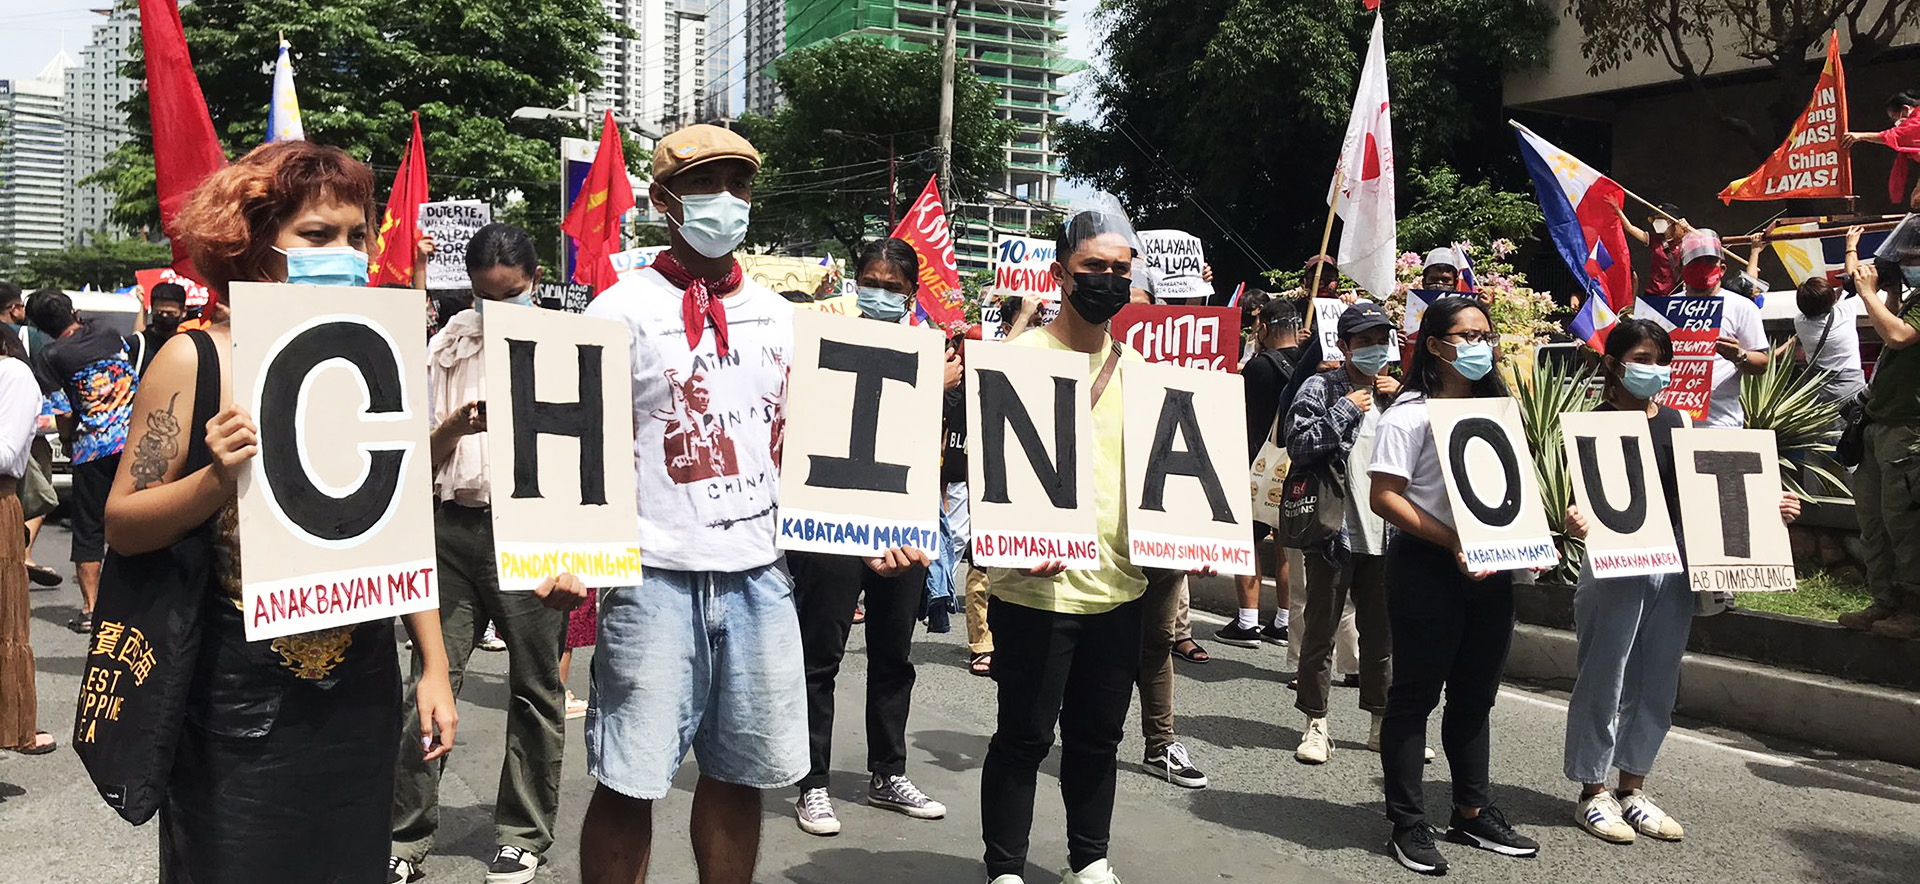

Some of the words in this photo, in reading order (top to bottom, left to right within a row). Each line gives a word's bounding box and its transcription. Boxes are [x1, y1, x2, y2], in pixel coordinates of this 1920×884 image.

[1807, 107, 1836, 124] ang
[1788, 149, 1838, 170] China
[1765, 168, 1838, 195] LAYAS!
[427, 205, 483, 219] DUTERTE,
[428, 229, 477, 243] PALPA
[1146, 239, 1201, 256] KALAYAAN
[1000, 239, 1027, 264] 10
[1147, 256, 1162, 268] SA
[1165, 257, 1201, 276] LUPA
[996, 266, 1057, 293] NGAYON
[1665, 299, 1723, 318] FIGHT
[1126, 314, 1220, 361] CHINA
[1682, 318, 1713, 333] FOR
[1671, 340, 1716, 354] REIGNTY!
[1670, 361, 1708, 376] HINA
[1685, 378, 1705, 390] OF
[507, 338, 609, 506] H
[805, 337, 919, 494] I
[259, 321, 407, 541] C
[974, 368, 1078, 509] N
[1138, 386, 1239, 525] A
[1449, 417, 1522, 527] O
[1574, 435, 1648, 535] U
[1693, 450, 1764, 559] T
[781, 517, 869, 546] KABATAAN
[873, 526, 938, 551] MAKATI
[975, 534, 995, 557] AB
[998, 535, 1097, 560] DIMASALANG
[501, 549, 559, 579] PANDAY
[561, 550, 616, 577] SINING
[1133, 539, 1176, 561] PANDAY
[1178, 544, 1219, 562] SINING
[1221, 546, 1251, 567] MKT
[1466, 547, 1518, 565] KABATAAN
[1517, 543, 1556, 562] MAKATI
[1594, 553, 1650, 572] ANAKBAYAN
[1692, 570, 1711, 590] AB
[1715, 565, 1792, 590] DIMASALANG
[254, 575, 382, 628] ANAKBAYAN
[387, 568, 433, 606] MKT
[86, 667, 121, 694] EST
